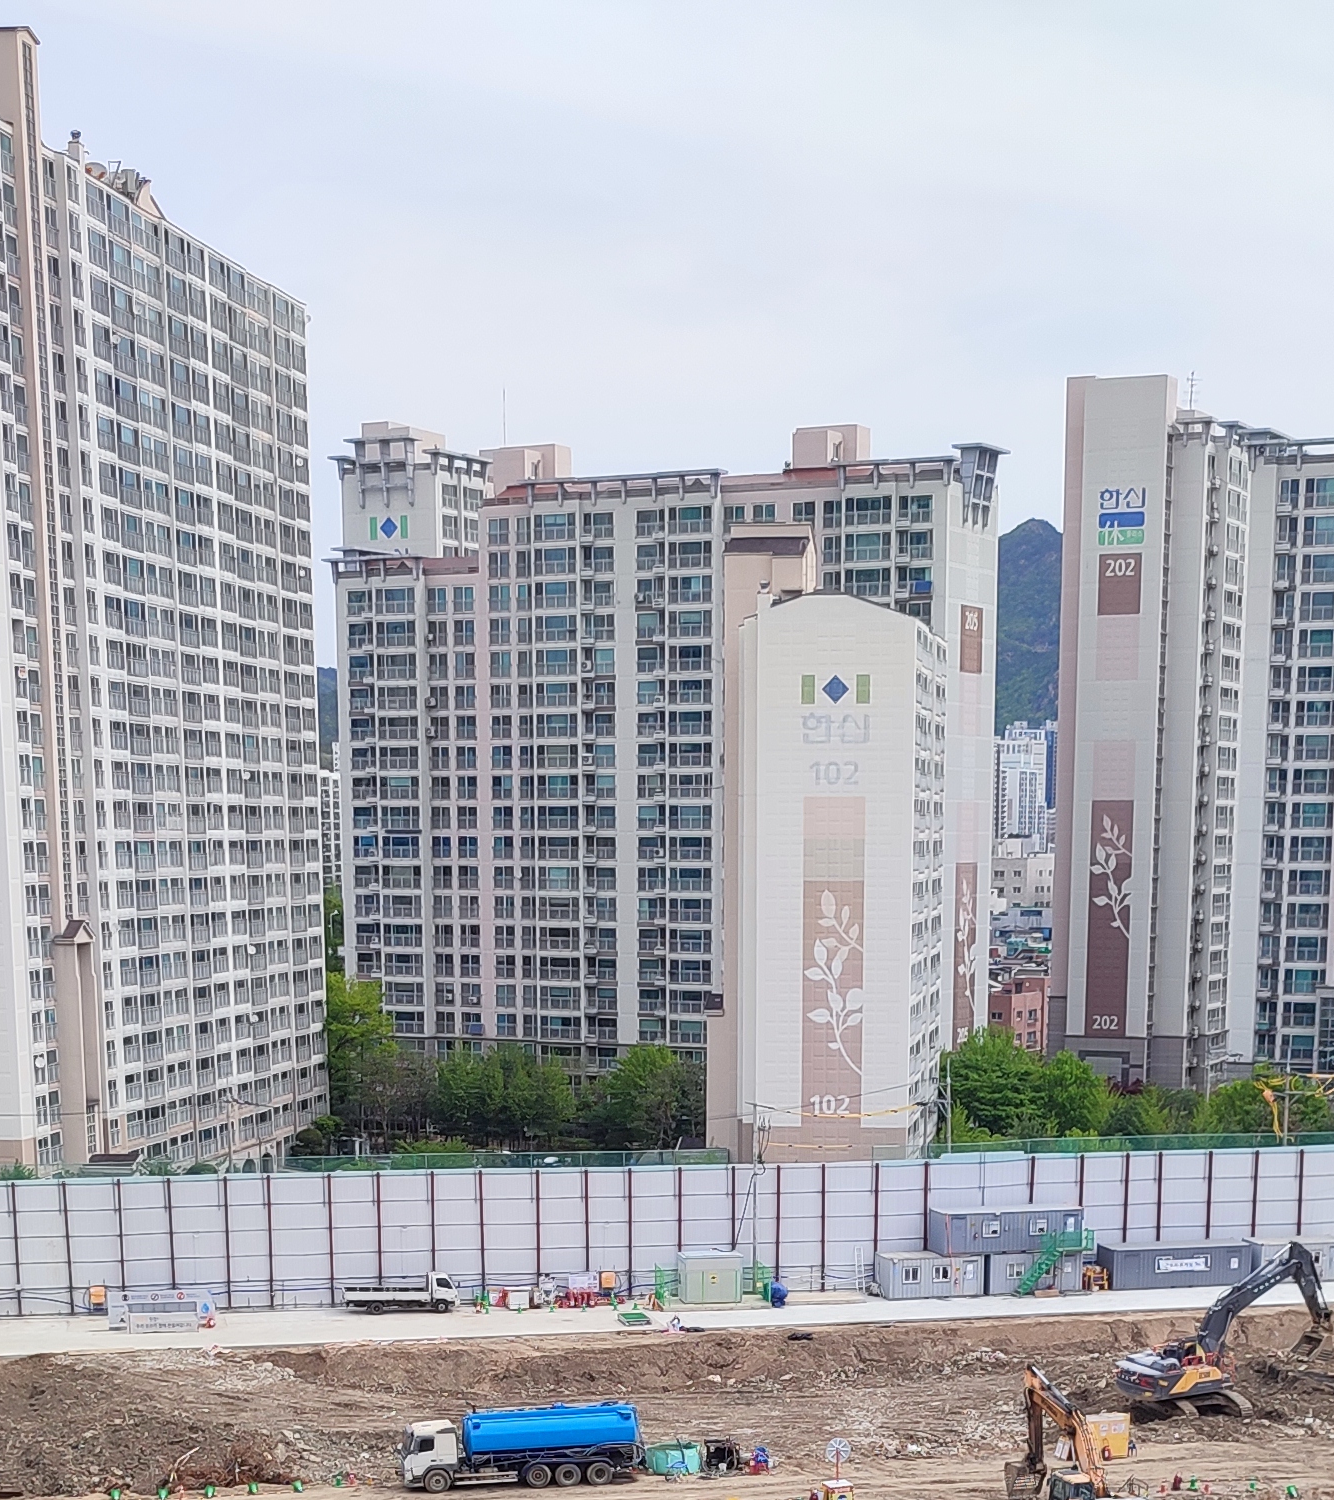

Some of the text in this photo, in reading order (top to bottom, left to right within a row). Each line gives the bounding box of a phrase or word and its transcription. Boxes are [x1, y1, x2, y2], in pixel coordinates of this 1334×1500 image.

[1099, 487, 1146, 510] 한신
[1105, 559, 1135, 577] 202
[965, 611, 978, 632] 205
[801, 712, 871, 744] 한신
[809, 761, 859, 786] 102
[1092, 1015, 1119, 1030] 202
[810, 1094, 850, 1115] 102
